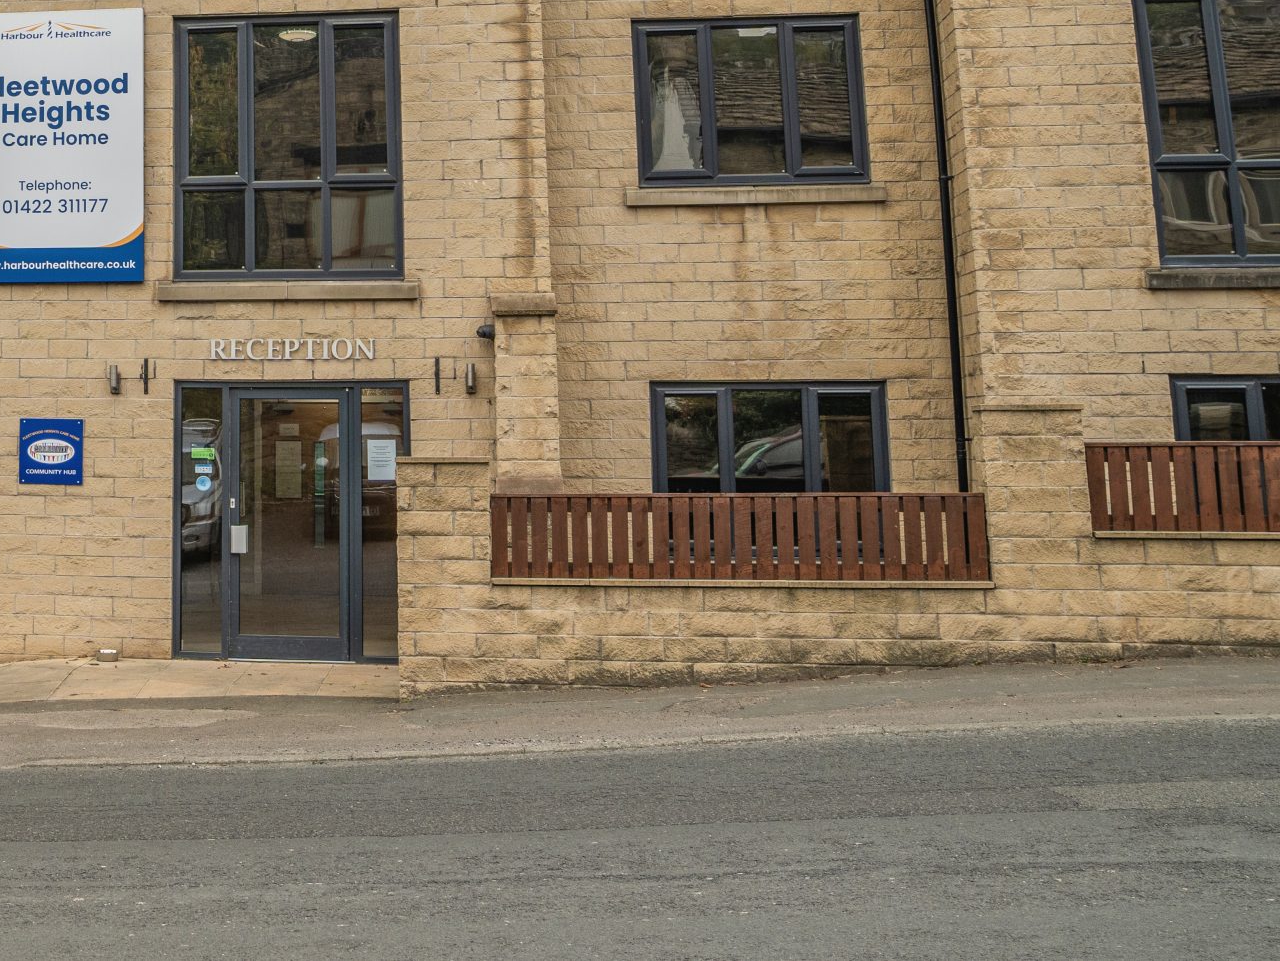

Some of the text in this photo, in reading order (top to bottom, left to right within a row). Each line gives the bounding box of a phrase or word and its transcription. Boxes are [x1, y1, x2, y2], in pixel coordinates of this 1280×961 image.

[1, 30, 112, 41] Harbour Healthcare
[1, 100, 110, 130] Heights
[2, 131, 109, 147] Care Home
[18, 179, 92, 194] Telephone:
[2, 198, 109, 214] 01422 311177
[209, 338, 375, 361] RECEPTION
